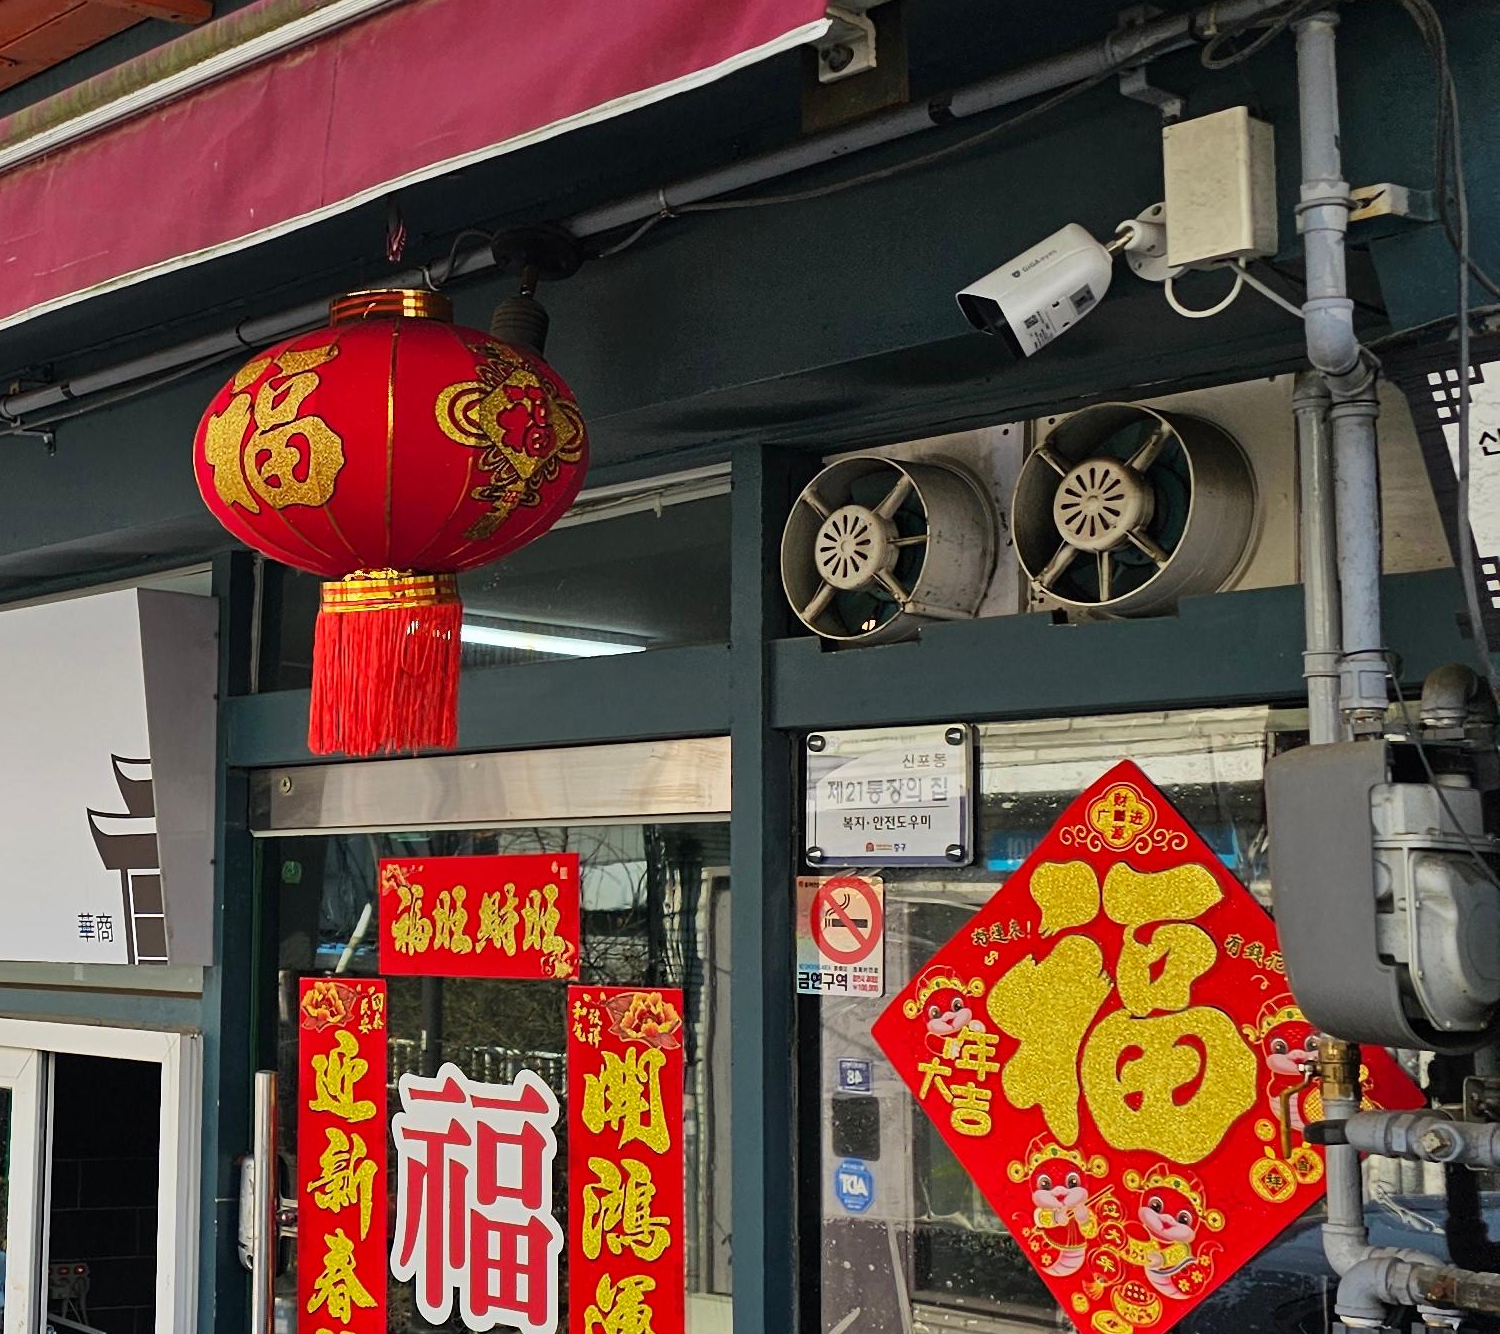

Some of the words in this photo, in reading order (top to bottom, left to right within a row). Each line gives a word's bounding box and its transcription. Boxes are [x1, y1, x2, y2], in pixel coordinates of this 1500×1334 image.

[204, 345, 345, 514] 福
[902, 753, 947, 769] 신포동
[77, 911, 114, 943] 華商
[798, 972, 847, 991] 금연구역
[986, 861, 1258, 1164] 福
